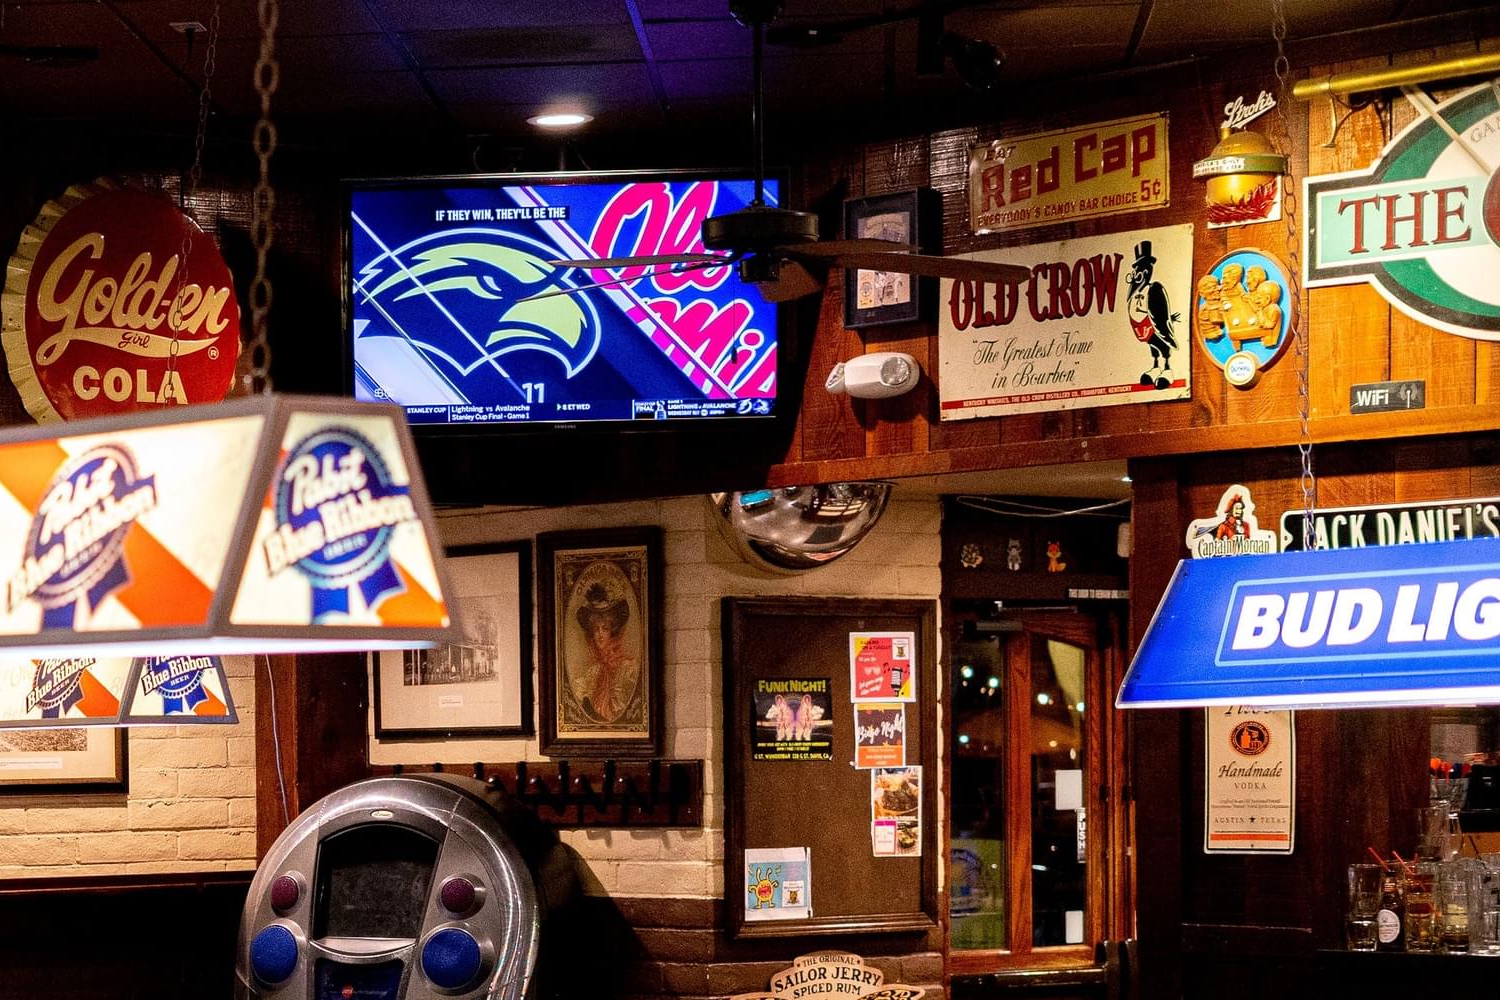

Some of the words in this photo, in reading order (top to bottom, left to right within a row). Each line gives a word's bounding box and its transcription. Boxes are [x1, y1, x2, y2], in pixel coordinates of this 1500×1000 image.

[1224, 90, 1276, 125] Stroh's
[1471, 115, 1500, 142] GA
[982, 146, 1060, 213] Red
[1074, 124, 1156, 183] Cap
[978, 206, 1041, 226] EVERYBODY'S
[1044, 202, 1075, 216] CANDY
[1079, 197, 1099, 211] BAR
[1102, 192, 1137, 206] CHOICE
[1141, 179, 1161, 202] 5¢
[436, 211, 444, 221] IF
[446, 210, 471, 221] THEY
[472, 210, 494, 221] WIN,
[496, 209, 532, 220] THEY'LL
[533, 209, 546, 219] BE
[547, 208, 566, 219] THE
[1338, 185, 1471, 254] THE
[36, 232, 230, 366] Gold-en
[948, 277, 1019, 331] OLD
[1026, 253, 1124, 322] CROW
[118, 331, 150, 348] Girl
[1002, 336, 1053, 371] Greatest
[1056, 331, 1094, 358] Name
[73, 365, 188, 405] COLA
[991, 372, 1008, 389] in
[522, 383, 545, 403] 11
[1357, 388, 1389, 407] WiFi
[407, 406, 433, 414] STANLEY
[451, 405, 483, 414] Lightning
[495, 404, 530, 412] Avalanche
[452, 413, 475, 422] Stanley
[475, 413, 488, 421] Cup
[1199, 538, 1233, 557] Captain
[1234, 535, 1270, 555] Morgan
[1231, 587, 1383, 650] BUD
[1387, 577, 1500, 643] LIG
[27, 682, 52, 712] Blue
[53, 657, 95, 688] Ribbon
[144, 670, 170, 694] Blue
[170, 657, 212, 677] Ribbon
[170, 674, 189, 686] BEER
[52, 680, 70, 696] BEER
[759, 680, 788, 693] FUNK
[789, 680, 826, 693] NIGHT!
[1218, 760, 1283, 778] Handmade
[1234, 782, 1267, 790] VODKA
[1214, 816, 1244, 824] AUSTIN
[1260, 816, 1287, 824] TEXAS
[1079, 812, 1087, 850] PUSH
[802, 958, 817, 968] THE
[819, 955, 855, 965] ORIGINAL
[774, 967, 827, 993] SAILOR
[831, 967, 882, 988] JERRY
[793, 982, 833, 999] SPICED
[836, 982, 862, 996] RUM
